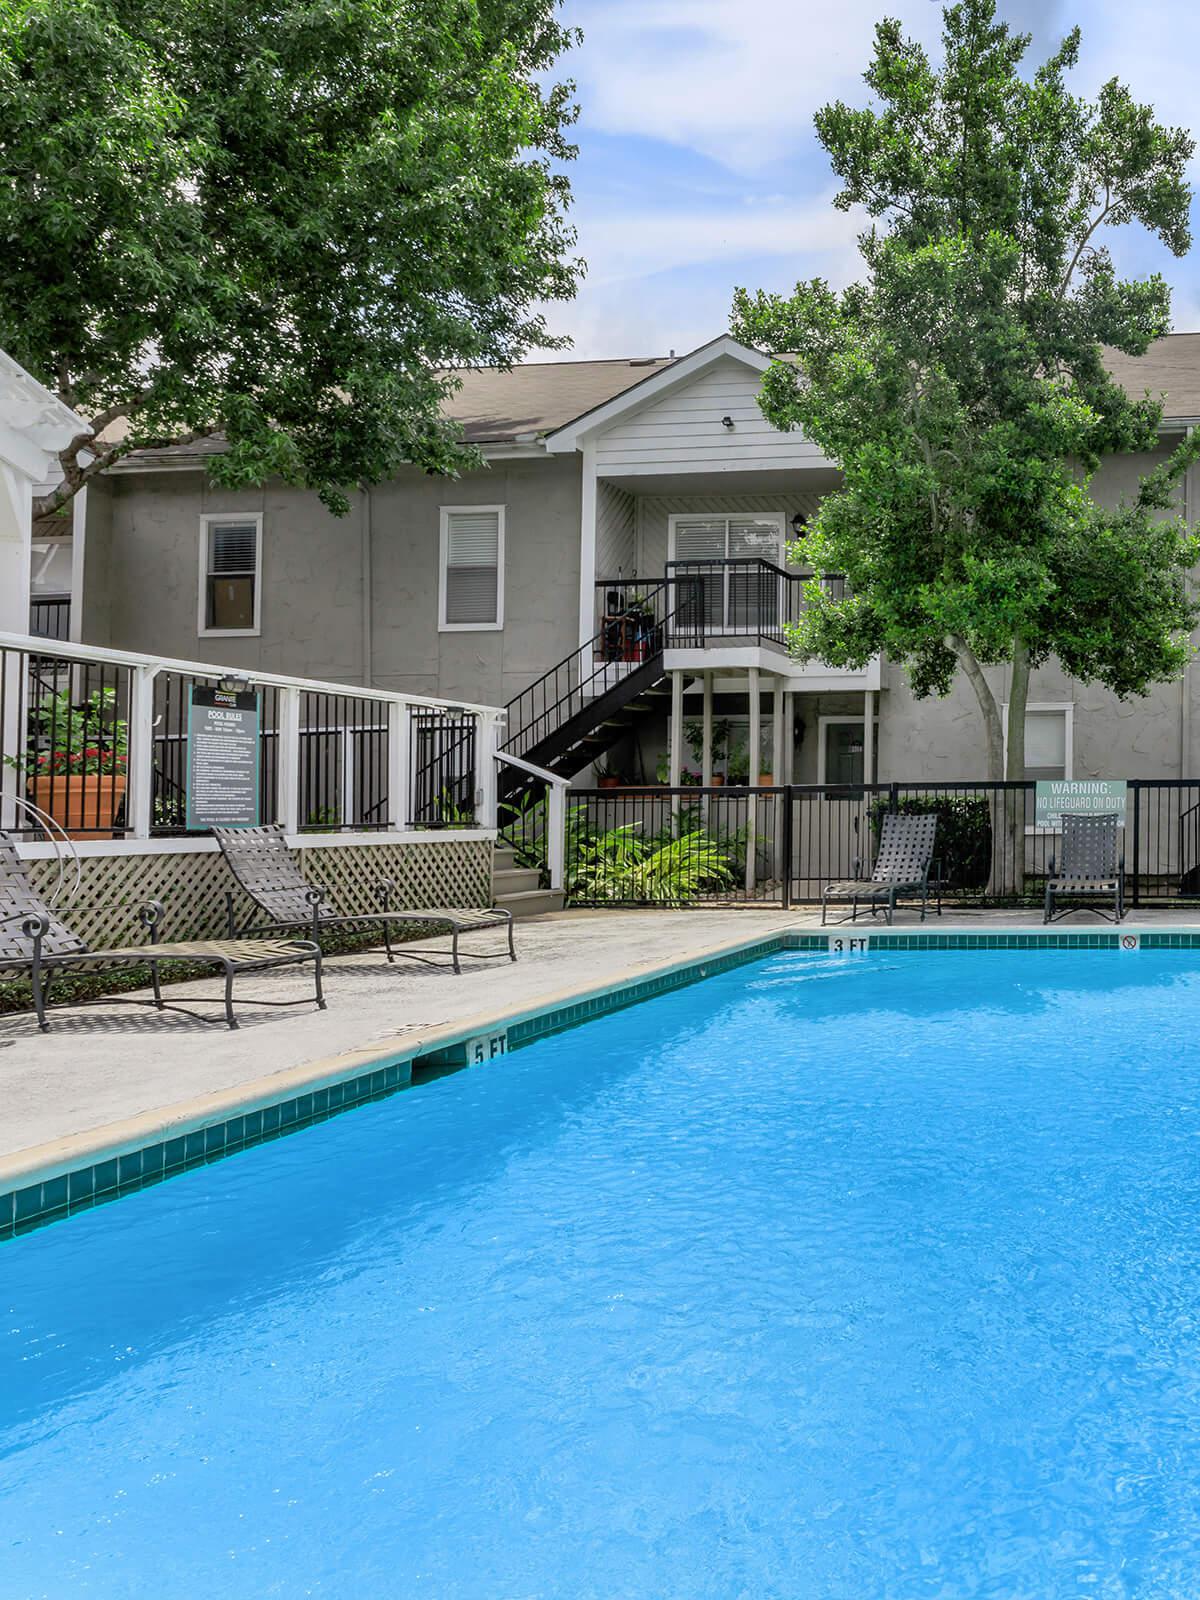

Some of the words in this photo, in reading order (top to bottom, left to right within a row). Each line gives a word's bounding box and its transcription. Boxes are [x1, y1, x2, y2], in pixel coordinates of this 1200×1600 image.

[208, 710, 224, 720] POOL
[1051, 783, 1112, 794] WARNING:
[1037, 797, 1048, 809] NO
[1050, 797, 1091, 809] LIFEGUARD
[1093, 797, 1104, 809] ON
[1105, 797, 1126, 809] DUTY
[834, 939, 843, 951] 3
[850, 938, 866, 951] FT
[475, 1043, 484, 1064] 5
[490, 1034, 506, 1059] FT
